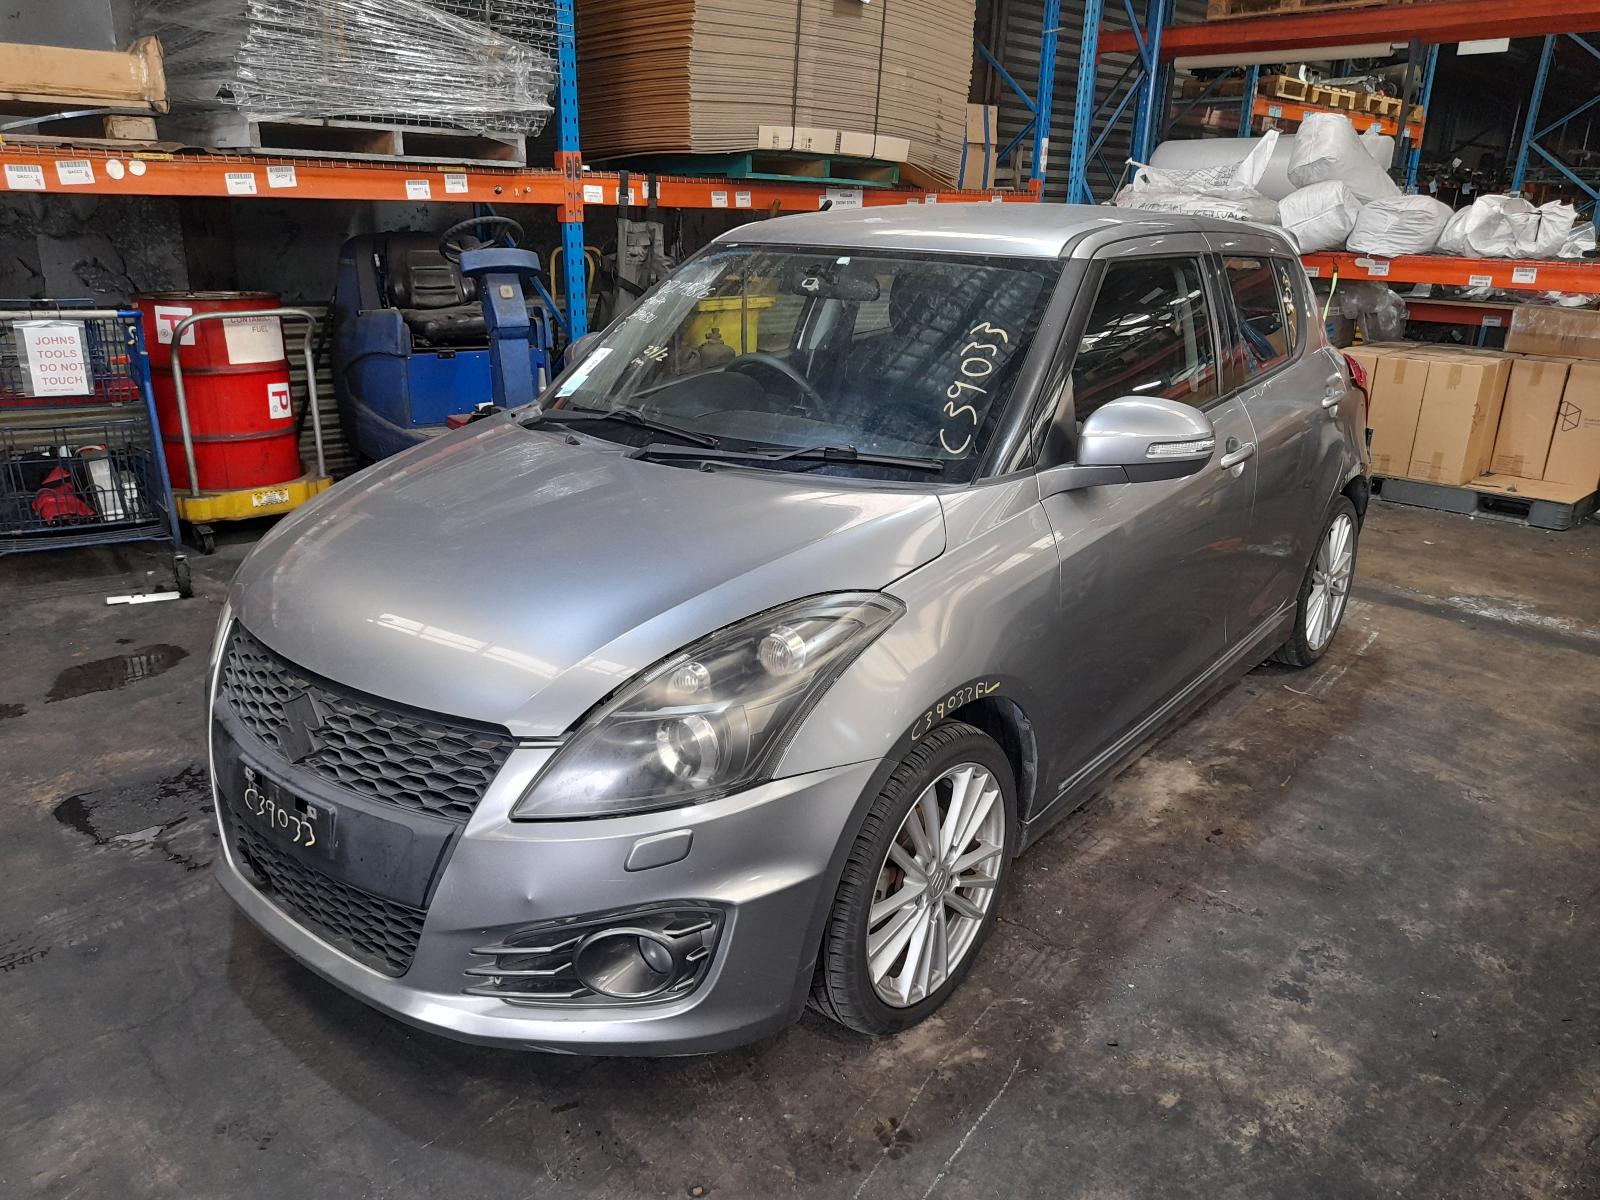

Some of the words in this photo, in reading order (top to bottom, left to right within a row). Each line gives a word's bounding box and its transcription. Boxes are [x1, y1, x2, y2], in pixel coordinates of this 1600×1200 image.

[35, 336, 76, 346] JOHNS
[37, 349, 78, 359] TOOLS
[39, 363, 58, 372] DO
[61, 362, 85, 371] NOT
[41, 376, 84, 386] TOUCH
